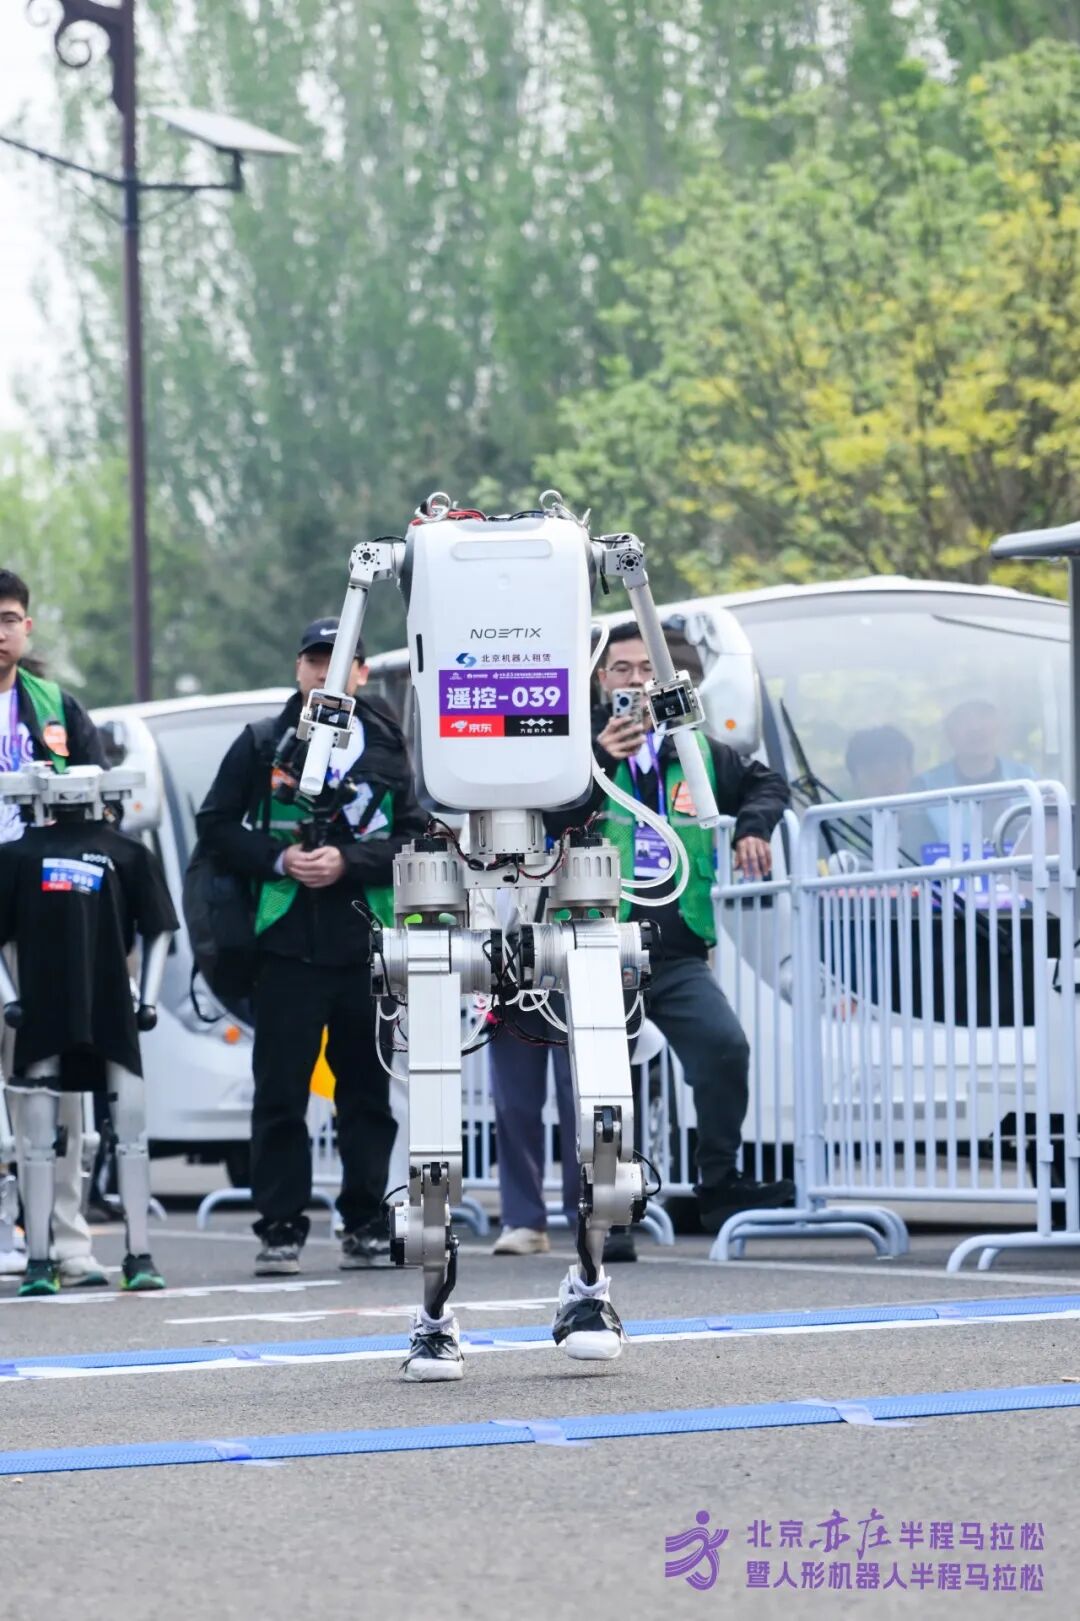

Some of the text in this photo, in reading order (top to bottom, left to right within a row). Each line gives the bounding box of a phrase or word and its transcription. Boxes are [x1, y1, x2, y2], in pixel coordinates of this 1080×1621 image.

[470, 627, 541, 639] NOETIX
[482, 653, 551, 663] 北京机器人租赁
[446, 686, 561, 710] 遥控-039
[469, 723, 492, 733] 京东
